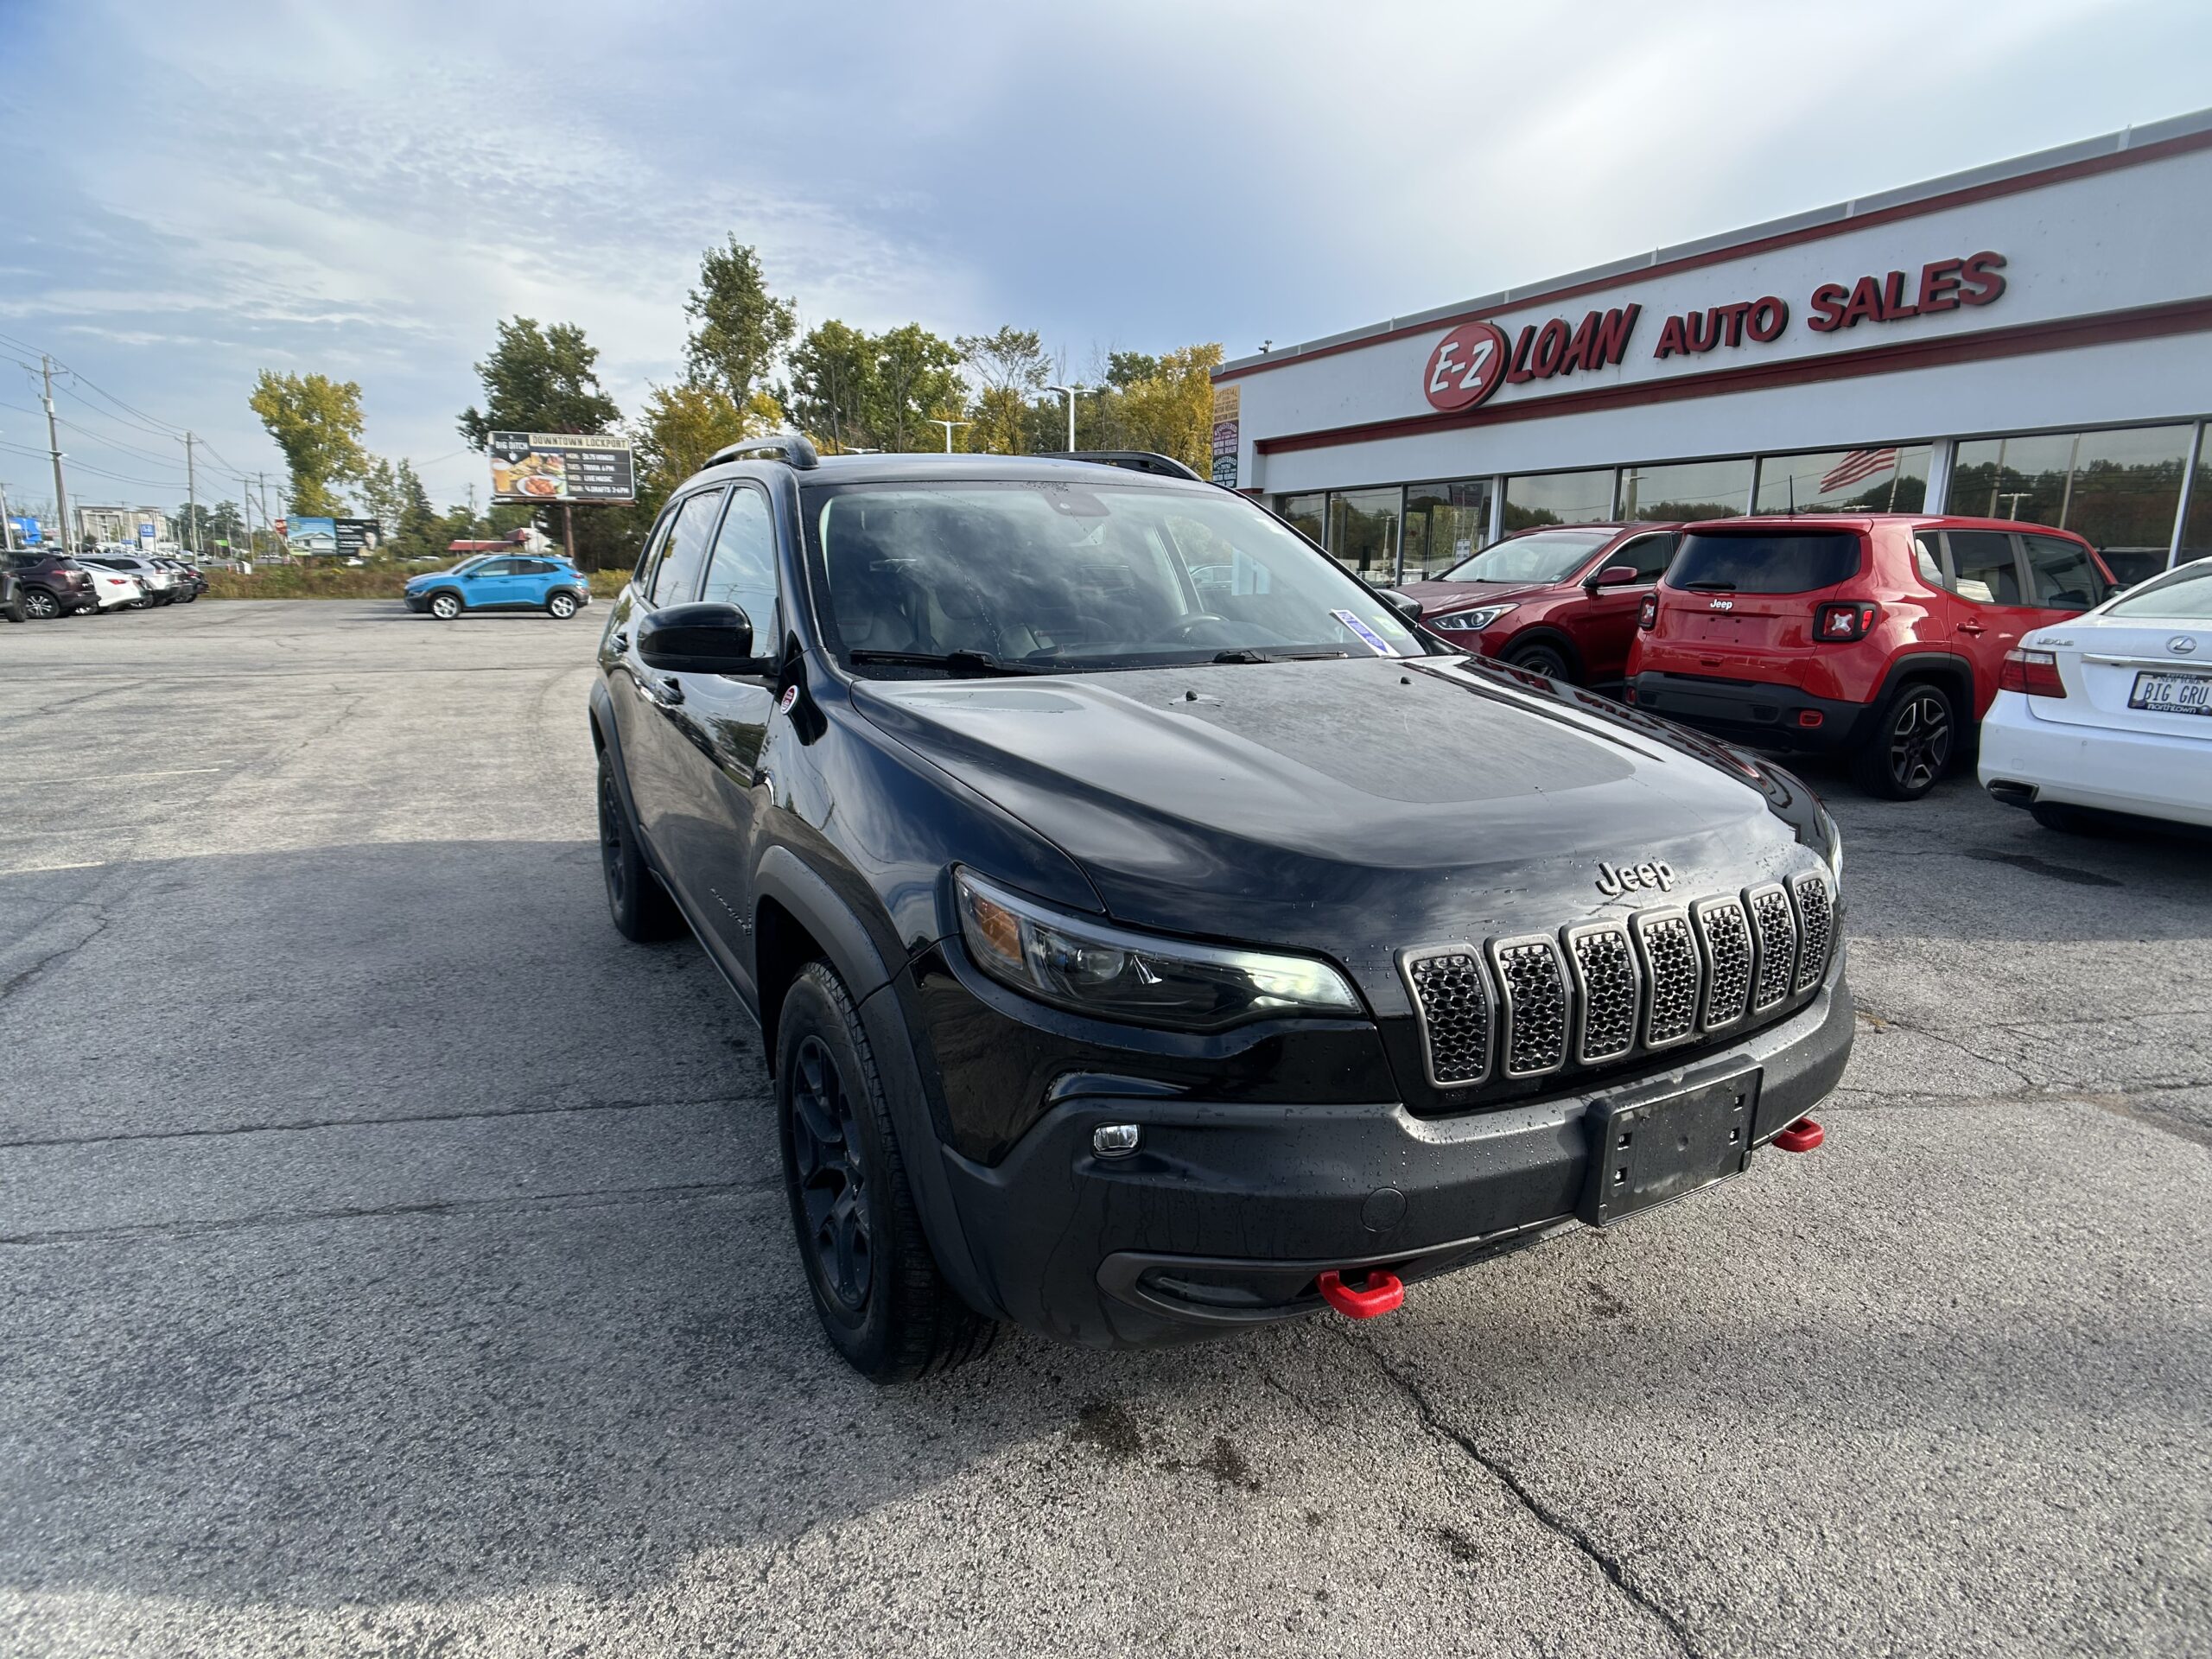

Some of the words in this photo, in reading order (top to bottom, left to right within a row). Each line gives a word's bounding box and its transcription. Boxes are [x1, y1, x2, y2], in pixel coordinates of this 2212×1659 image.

[1429, 340, 1494, 393] E-Z
[1506, 302, 1643, 384] LOAN
[1652, 296, 1789, 359] AUTO
[1807, 250, 2007, 333] SALES
[495, 441, 508, 449] BIG
[508, 442, 529, 450] DITCH
[532, 435, 582, 447] DOWNTOWN
[586, 438, 626, 448] LOCKPORT
[582, 463, 601, 472] TRIVIA
[1710, 599, 1733, 611] Jeep
[2037, 638, 2075, 646] LEXUS
[2157, 677, 2178, 685] NEW
[2180, 678, 2202, 687] YORK
[2144, 682, 2172, 702] BIG
[2179, 685, 2210, 705] GRU
[2147, 702, 2197, 715] northtown
[1594, 860, 1676, 895] Jeep
